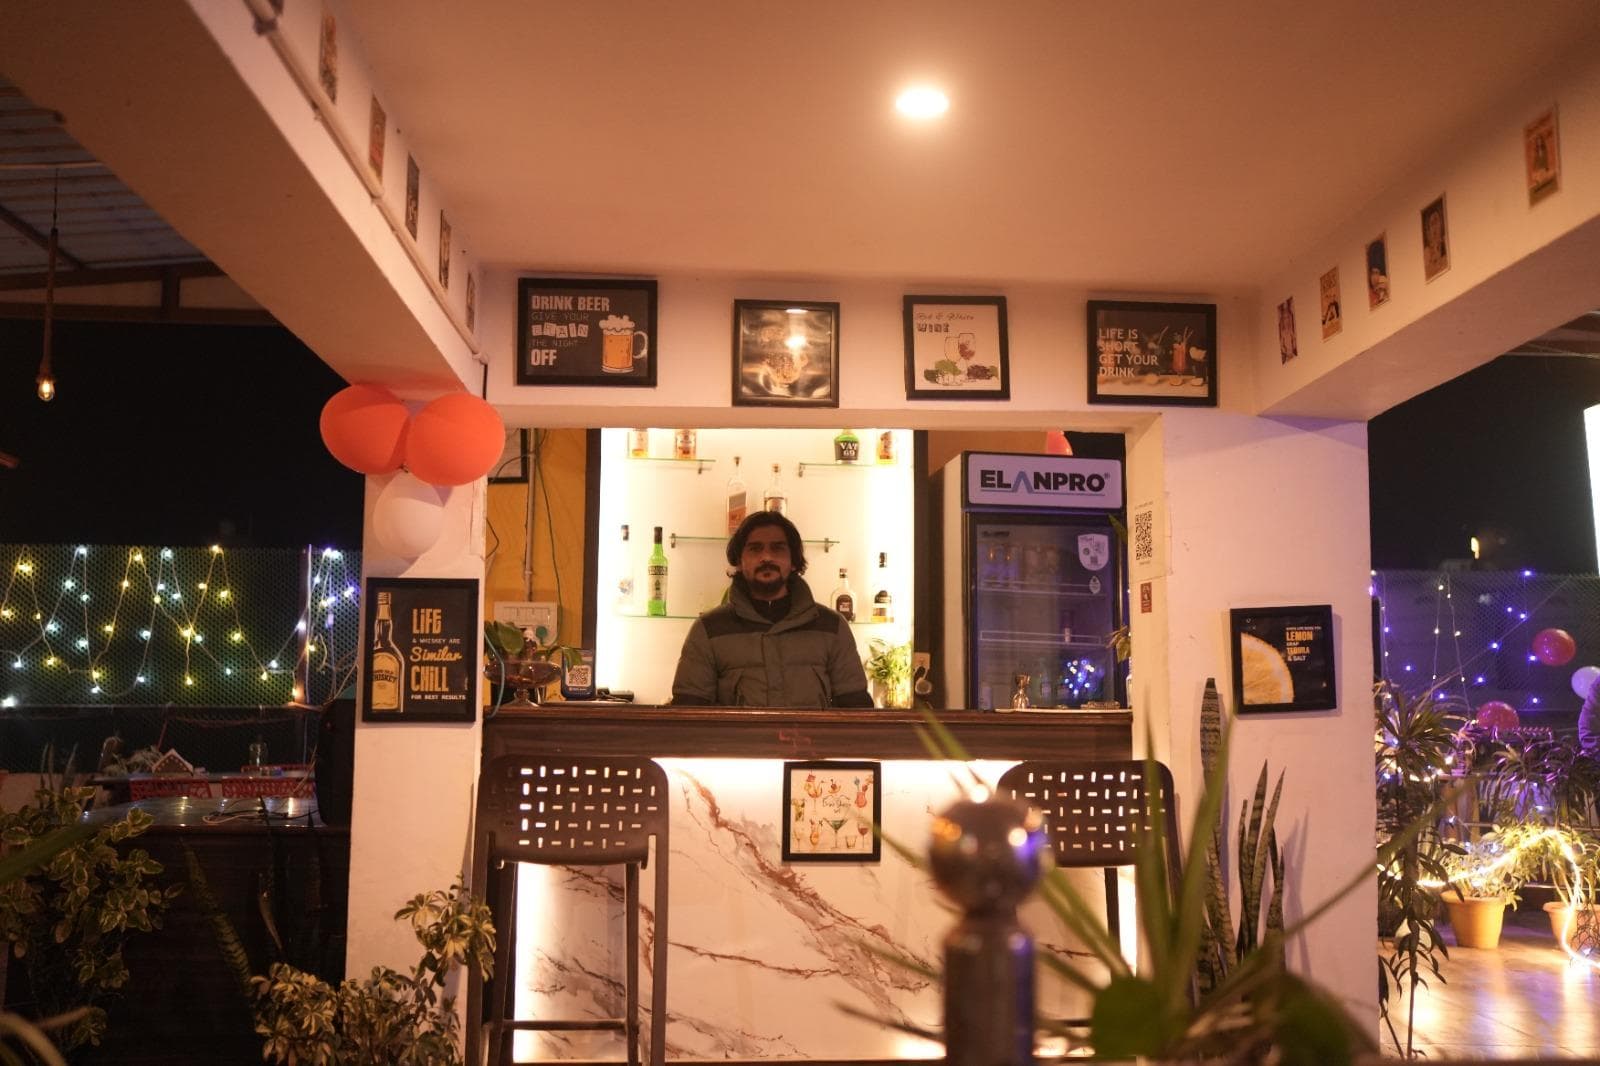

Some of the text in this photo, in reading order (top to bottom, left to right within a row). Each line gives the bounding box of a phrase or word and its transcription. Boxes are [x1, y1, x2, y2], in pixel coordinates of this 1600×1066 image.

[532, 295, 610, 311] DRINK BEER
[565, 312, 589, 321] YOUR
[1099, 328, 1139, 339] LIFE IS
[1098, 340, 1139, 352] SHORT
[530, 349, 557, 366] OFF
[1098, 353, 1159, 366] GET YOUR
[1099, 366, 1135, 378] DRINK
[840, 442, 857, 450] VAT
[980, 469, 1106, 494] ELANPRO
[1286, 631, 1313, 641] LEMON
[410, 646, 463, 662] Similar
